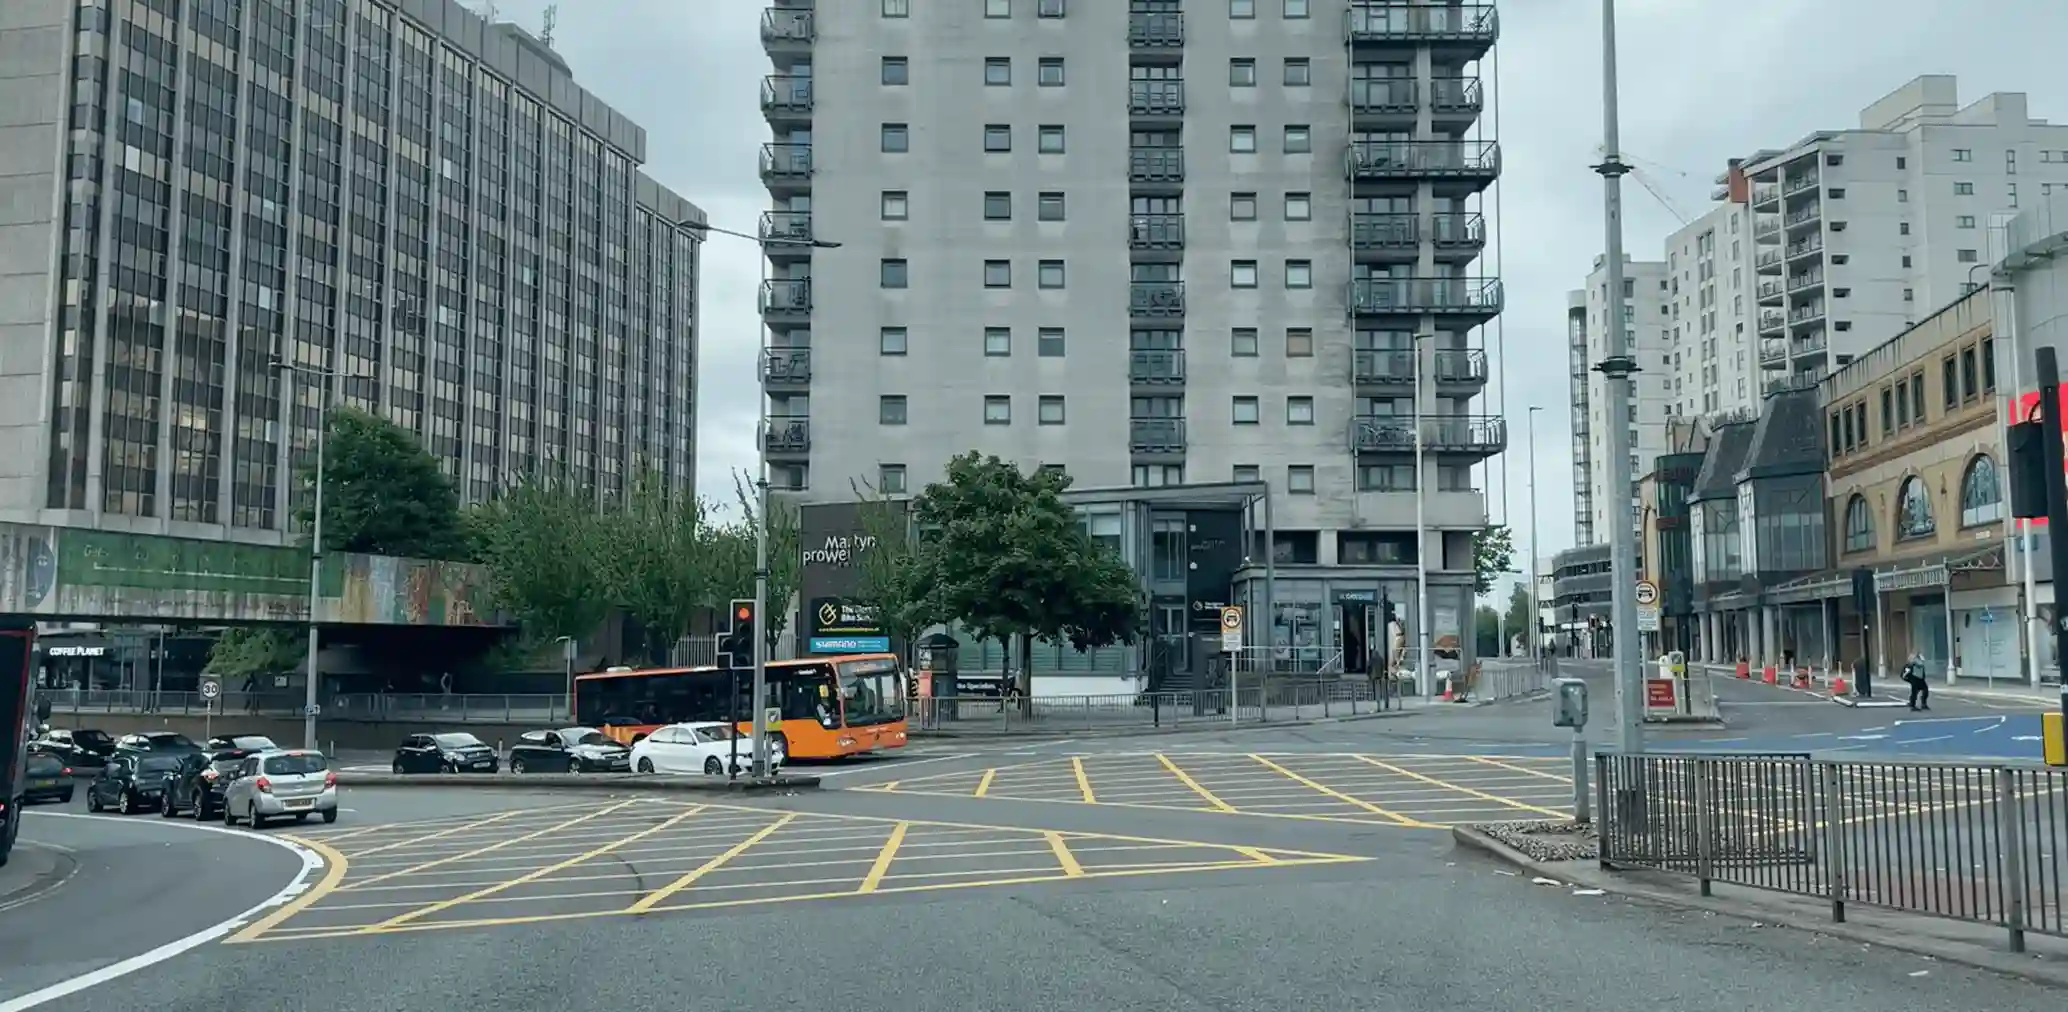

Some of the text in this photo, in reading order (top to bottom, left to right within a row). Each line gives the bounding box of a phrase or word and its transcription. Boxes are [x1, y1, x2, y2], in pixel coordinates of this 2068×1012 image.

[49, 645, 104, 656] COFFEE PLANET
[203, 685, 218, 693] 30
